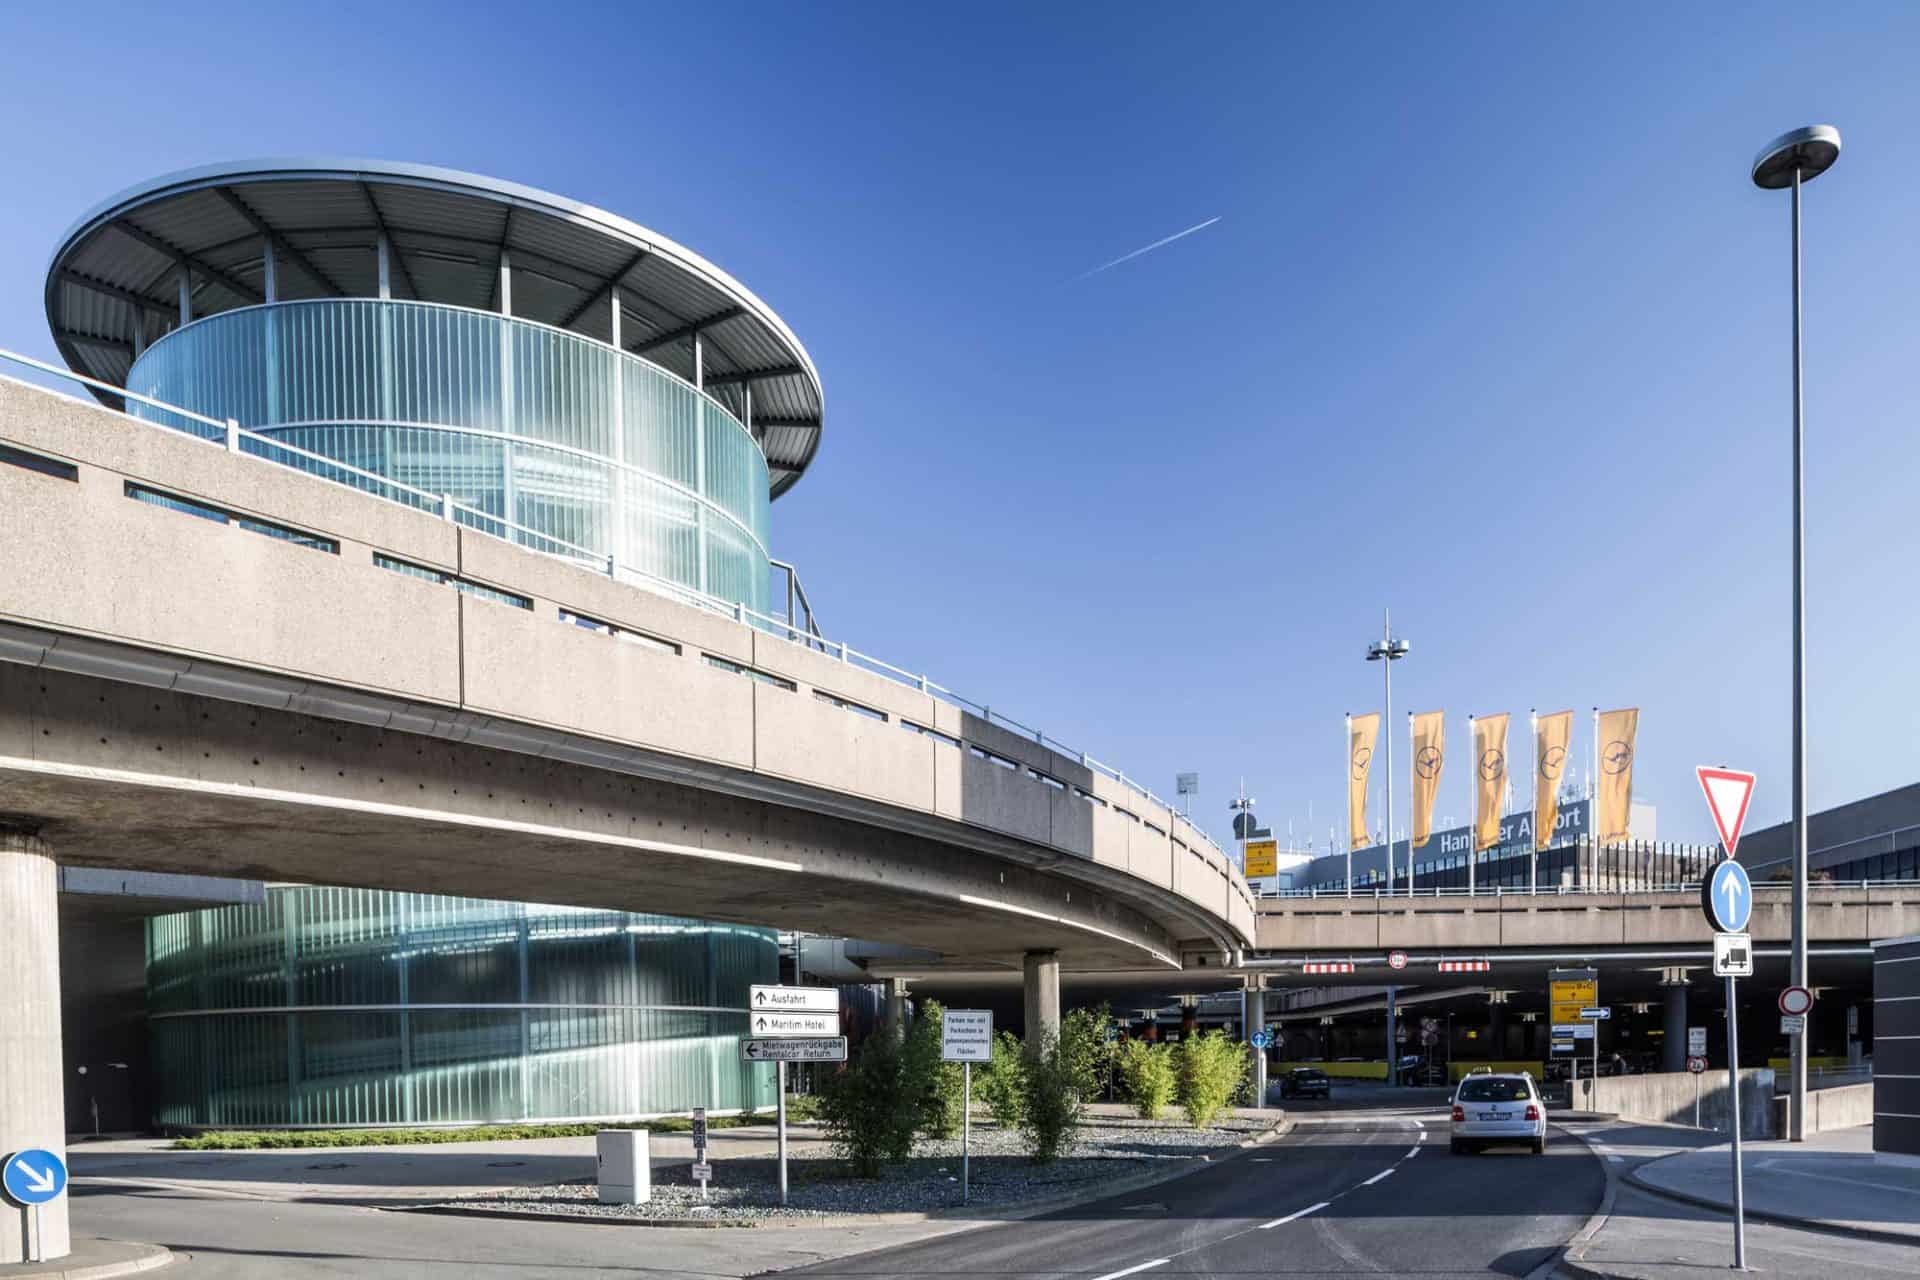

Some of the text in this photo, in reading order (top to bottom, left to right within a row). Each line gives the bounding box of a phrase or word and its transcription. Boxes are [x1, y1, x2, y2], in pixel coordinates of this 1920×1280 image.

[1441, 807, 1580, 852] Hanner Aort
[771, 993, 806, 1004] Ausfahrt
[771, 1019, 826, 1031] Maritim Hotel
